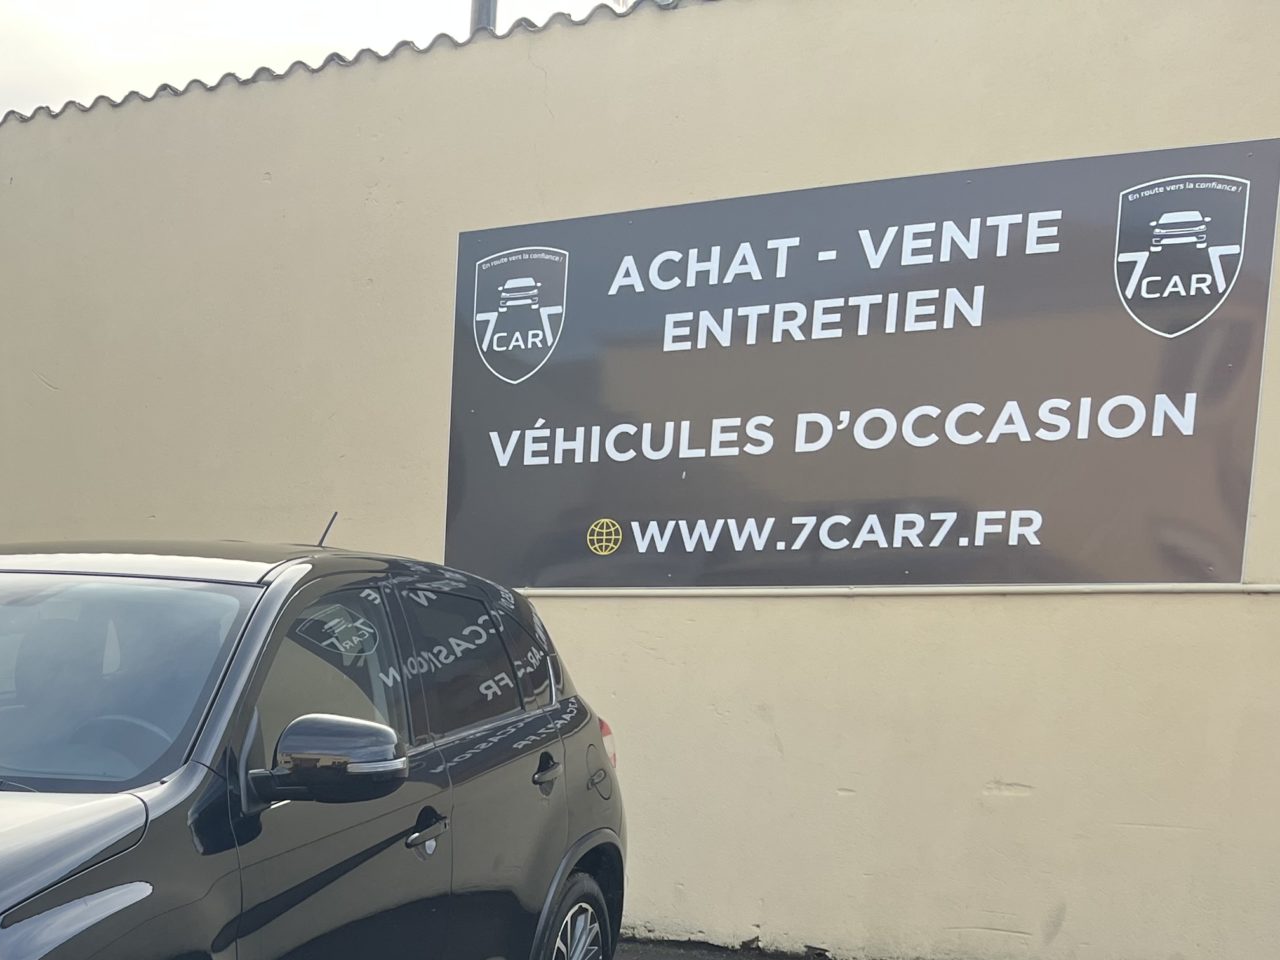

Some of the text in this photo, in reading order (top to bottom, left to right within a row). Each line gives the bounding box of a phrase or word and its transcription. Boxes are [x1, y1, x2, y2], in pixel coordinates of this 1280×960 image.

[1128, 193, 1140, 201] En
[1140, 186, 1165, 198] route
[1165, 183, 1185, 192] vers
[1185, 181, 1195, 189] la
[1195, 181, 1238, 193] confiance
[607, 236, 801, 294] ACHAT
[858, 209, 1063, 269] VENTE
[663, 285, 986, 352] ENTRETIEN
[489, 415, 774, 467] VÉHICULES
[630, 509, 1044, 553] WWW.7CAR7.FR
